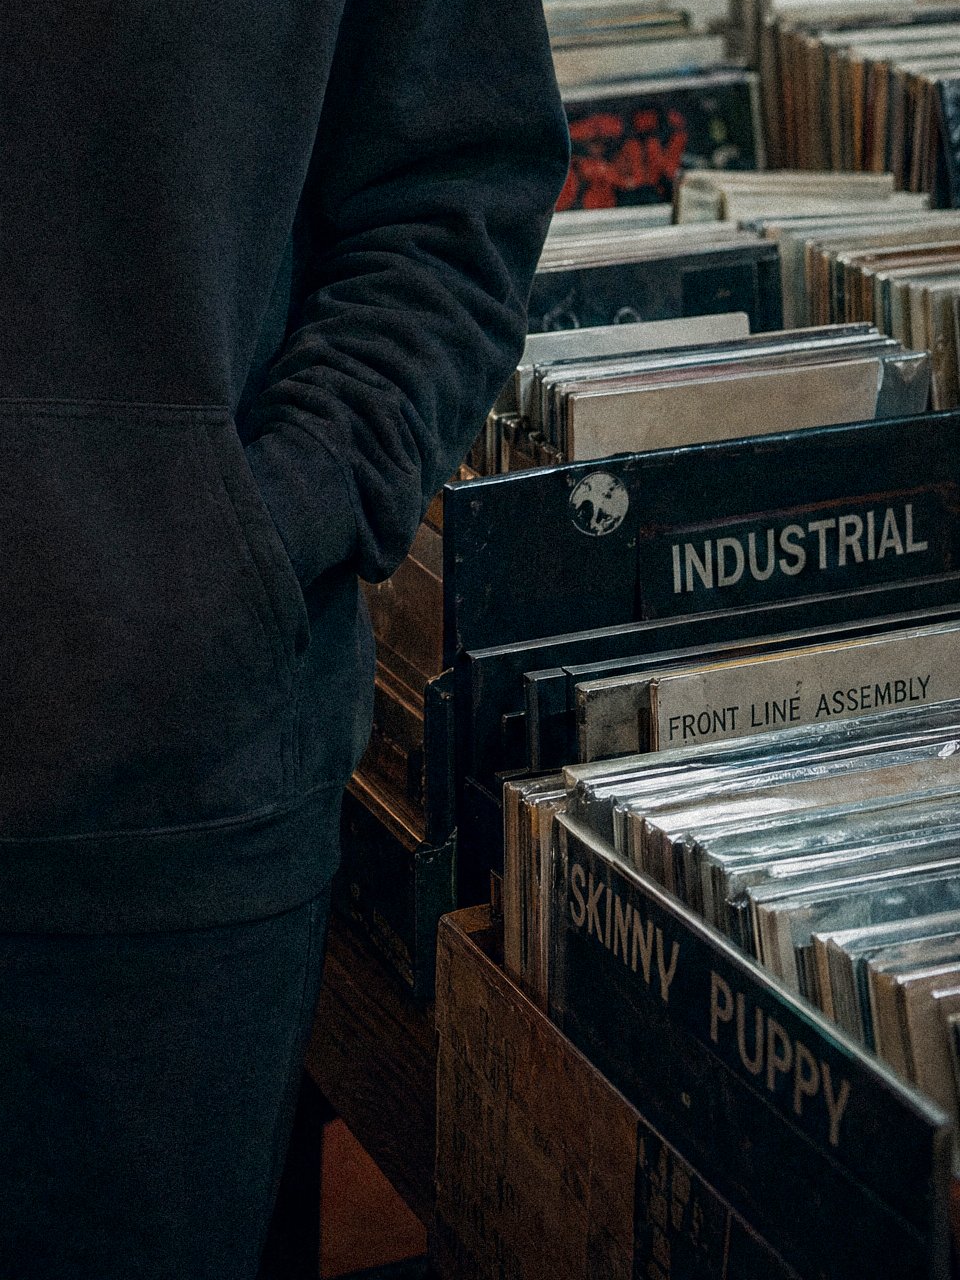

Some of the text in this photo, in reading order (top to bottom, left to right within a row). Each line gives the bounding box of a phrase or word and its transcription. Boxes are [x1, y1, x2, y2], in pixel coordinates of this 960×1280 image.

[672, 504, 929, 594] INDUSTRIAL
[668, 706, 739, 741] FRONT
[815, 674, 931, 719] ASSEMBLY
[570, 863, 851, 1146] SKINNY PUPPY
